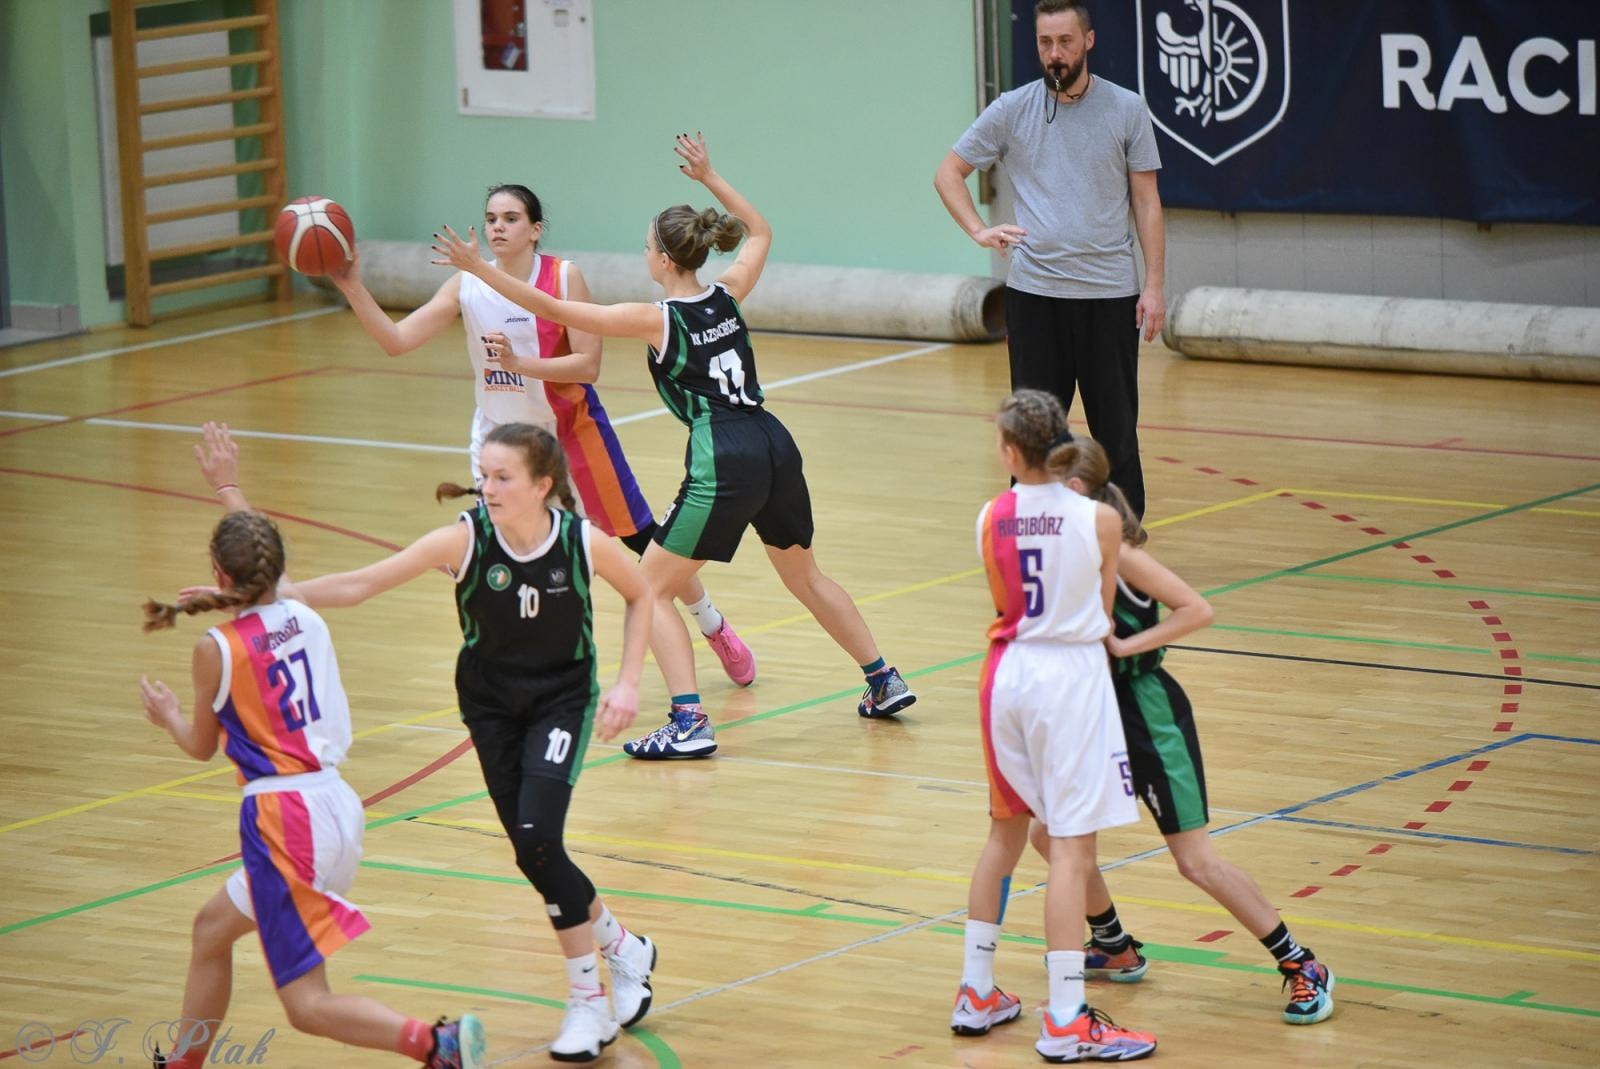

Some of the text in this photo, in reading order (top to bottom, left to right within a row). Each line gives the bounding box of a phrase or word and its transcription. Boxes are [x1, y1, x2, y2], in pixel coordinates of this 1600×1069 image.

[1380, 33, 1597, 116] RACI
[997, 511, 1064, 537] RACIBÓRZ
[517, 583, 540, 619] 10
[1018, 548, 1045, 618] 5
[267, 648, 322, 733] 27
[544, 727, 572, 764] 10
